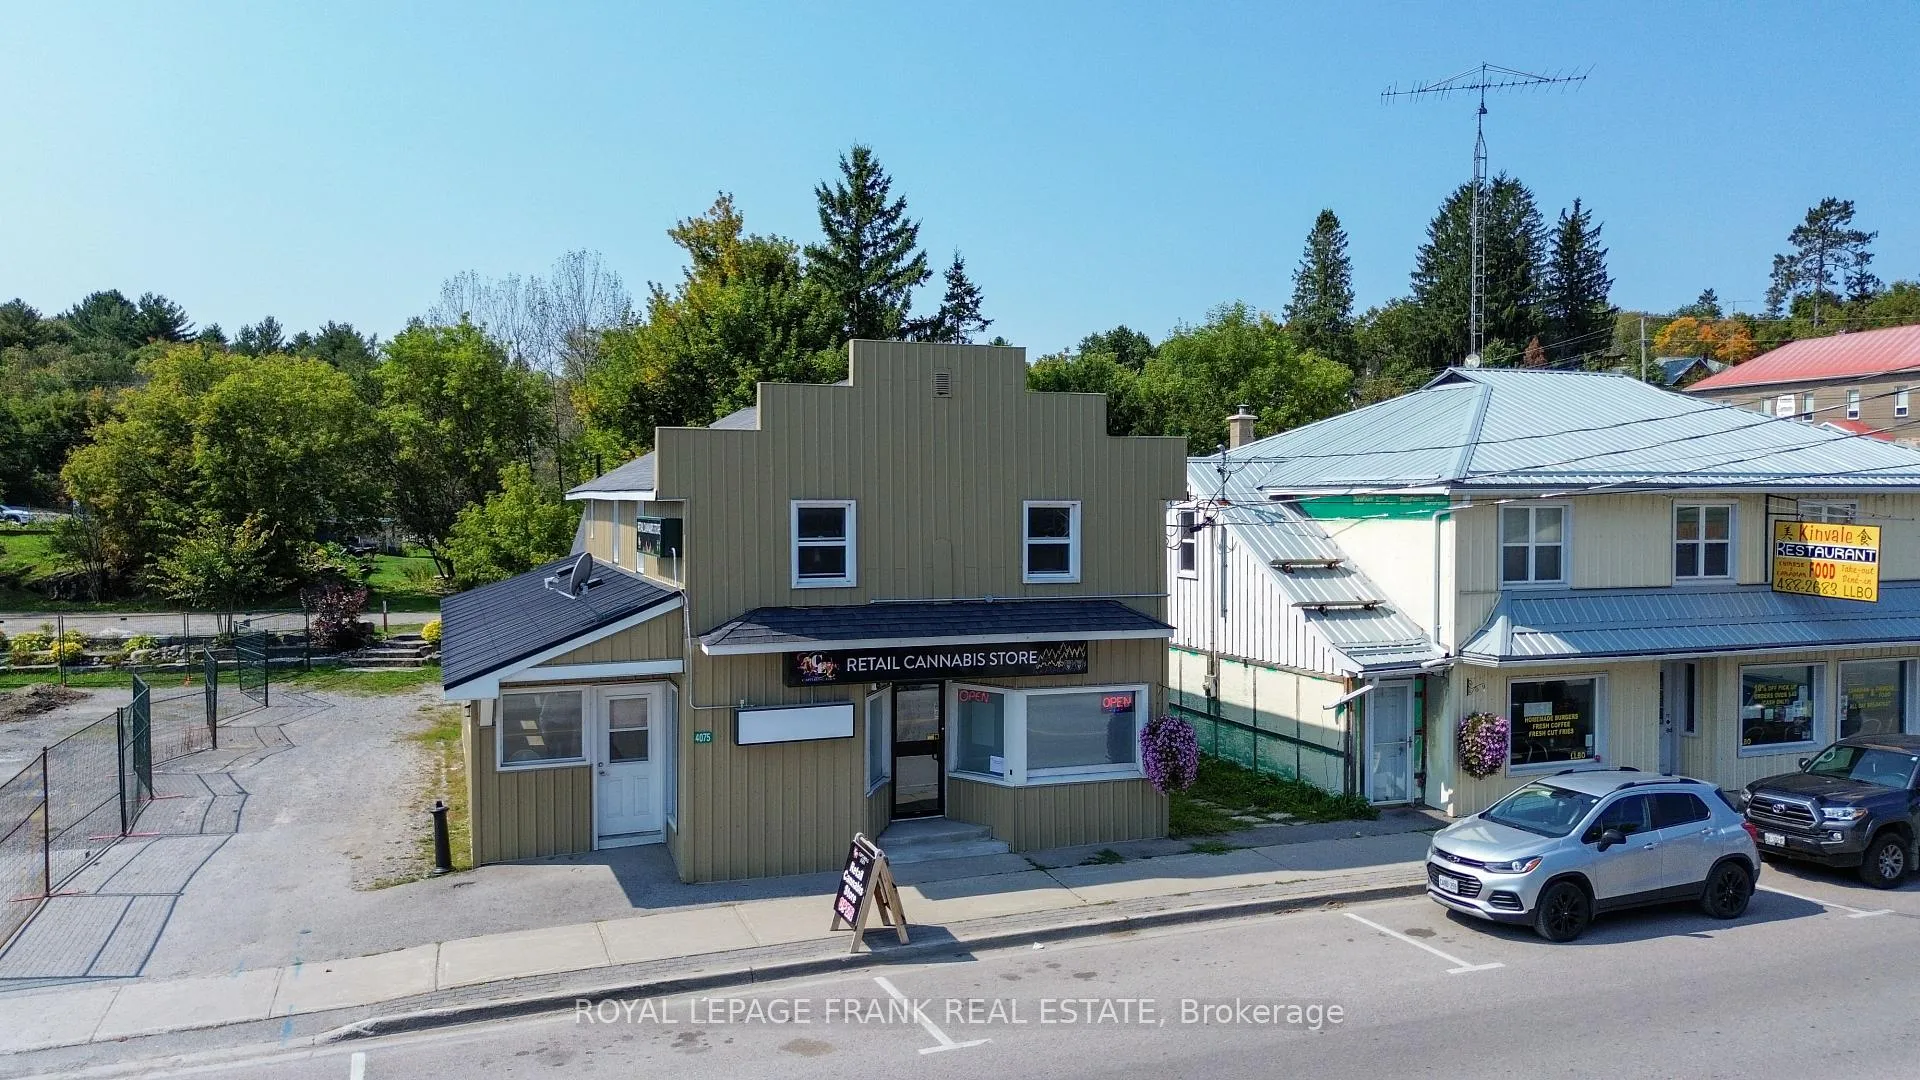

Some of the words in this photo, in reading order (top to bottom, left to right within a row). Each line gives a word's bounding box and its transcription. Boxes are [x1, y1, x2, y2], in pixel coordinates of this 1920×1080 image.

[1799, 525, 1853, 544] Kinvale
[1776, 541, 1876, 562] RESTAURANT
[1809, 562, 1836, 580] FOOD
[1776, 578, 1838, 596] 488-2683
[1843, 584, 1873, 599] LLBO
[846, 656, 900, 673] RETAIL
[903, 653, 986, 669] CANNABIS
[989, 650, 1038, 665] STORE
[959, 689, 989, 704] OPEN
[1102, 695, 1132, 709] OPEN
[1524, 715, 1554, 723] HOMEMADE
[1554, 713, 1579, 721] BURGERS
[1532, 722, 1550, 730] FRESH
[1550, 721, 1571, 729] COFFEE
[695, 733, 711, 742] 4075
